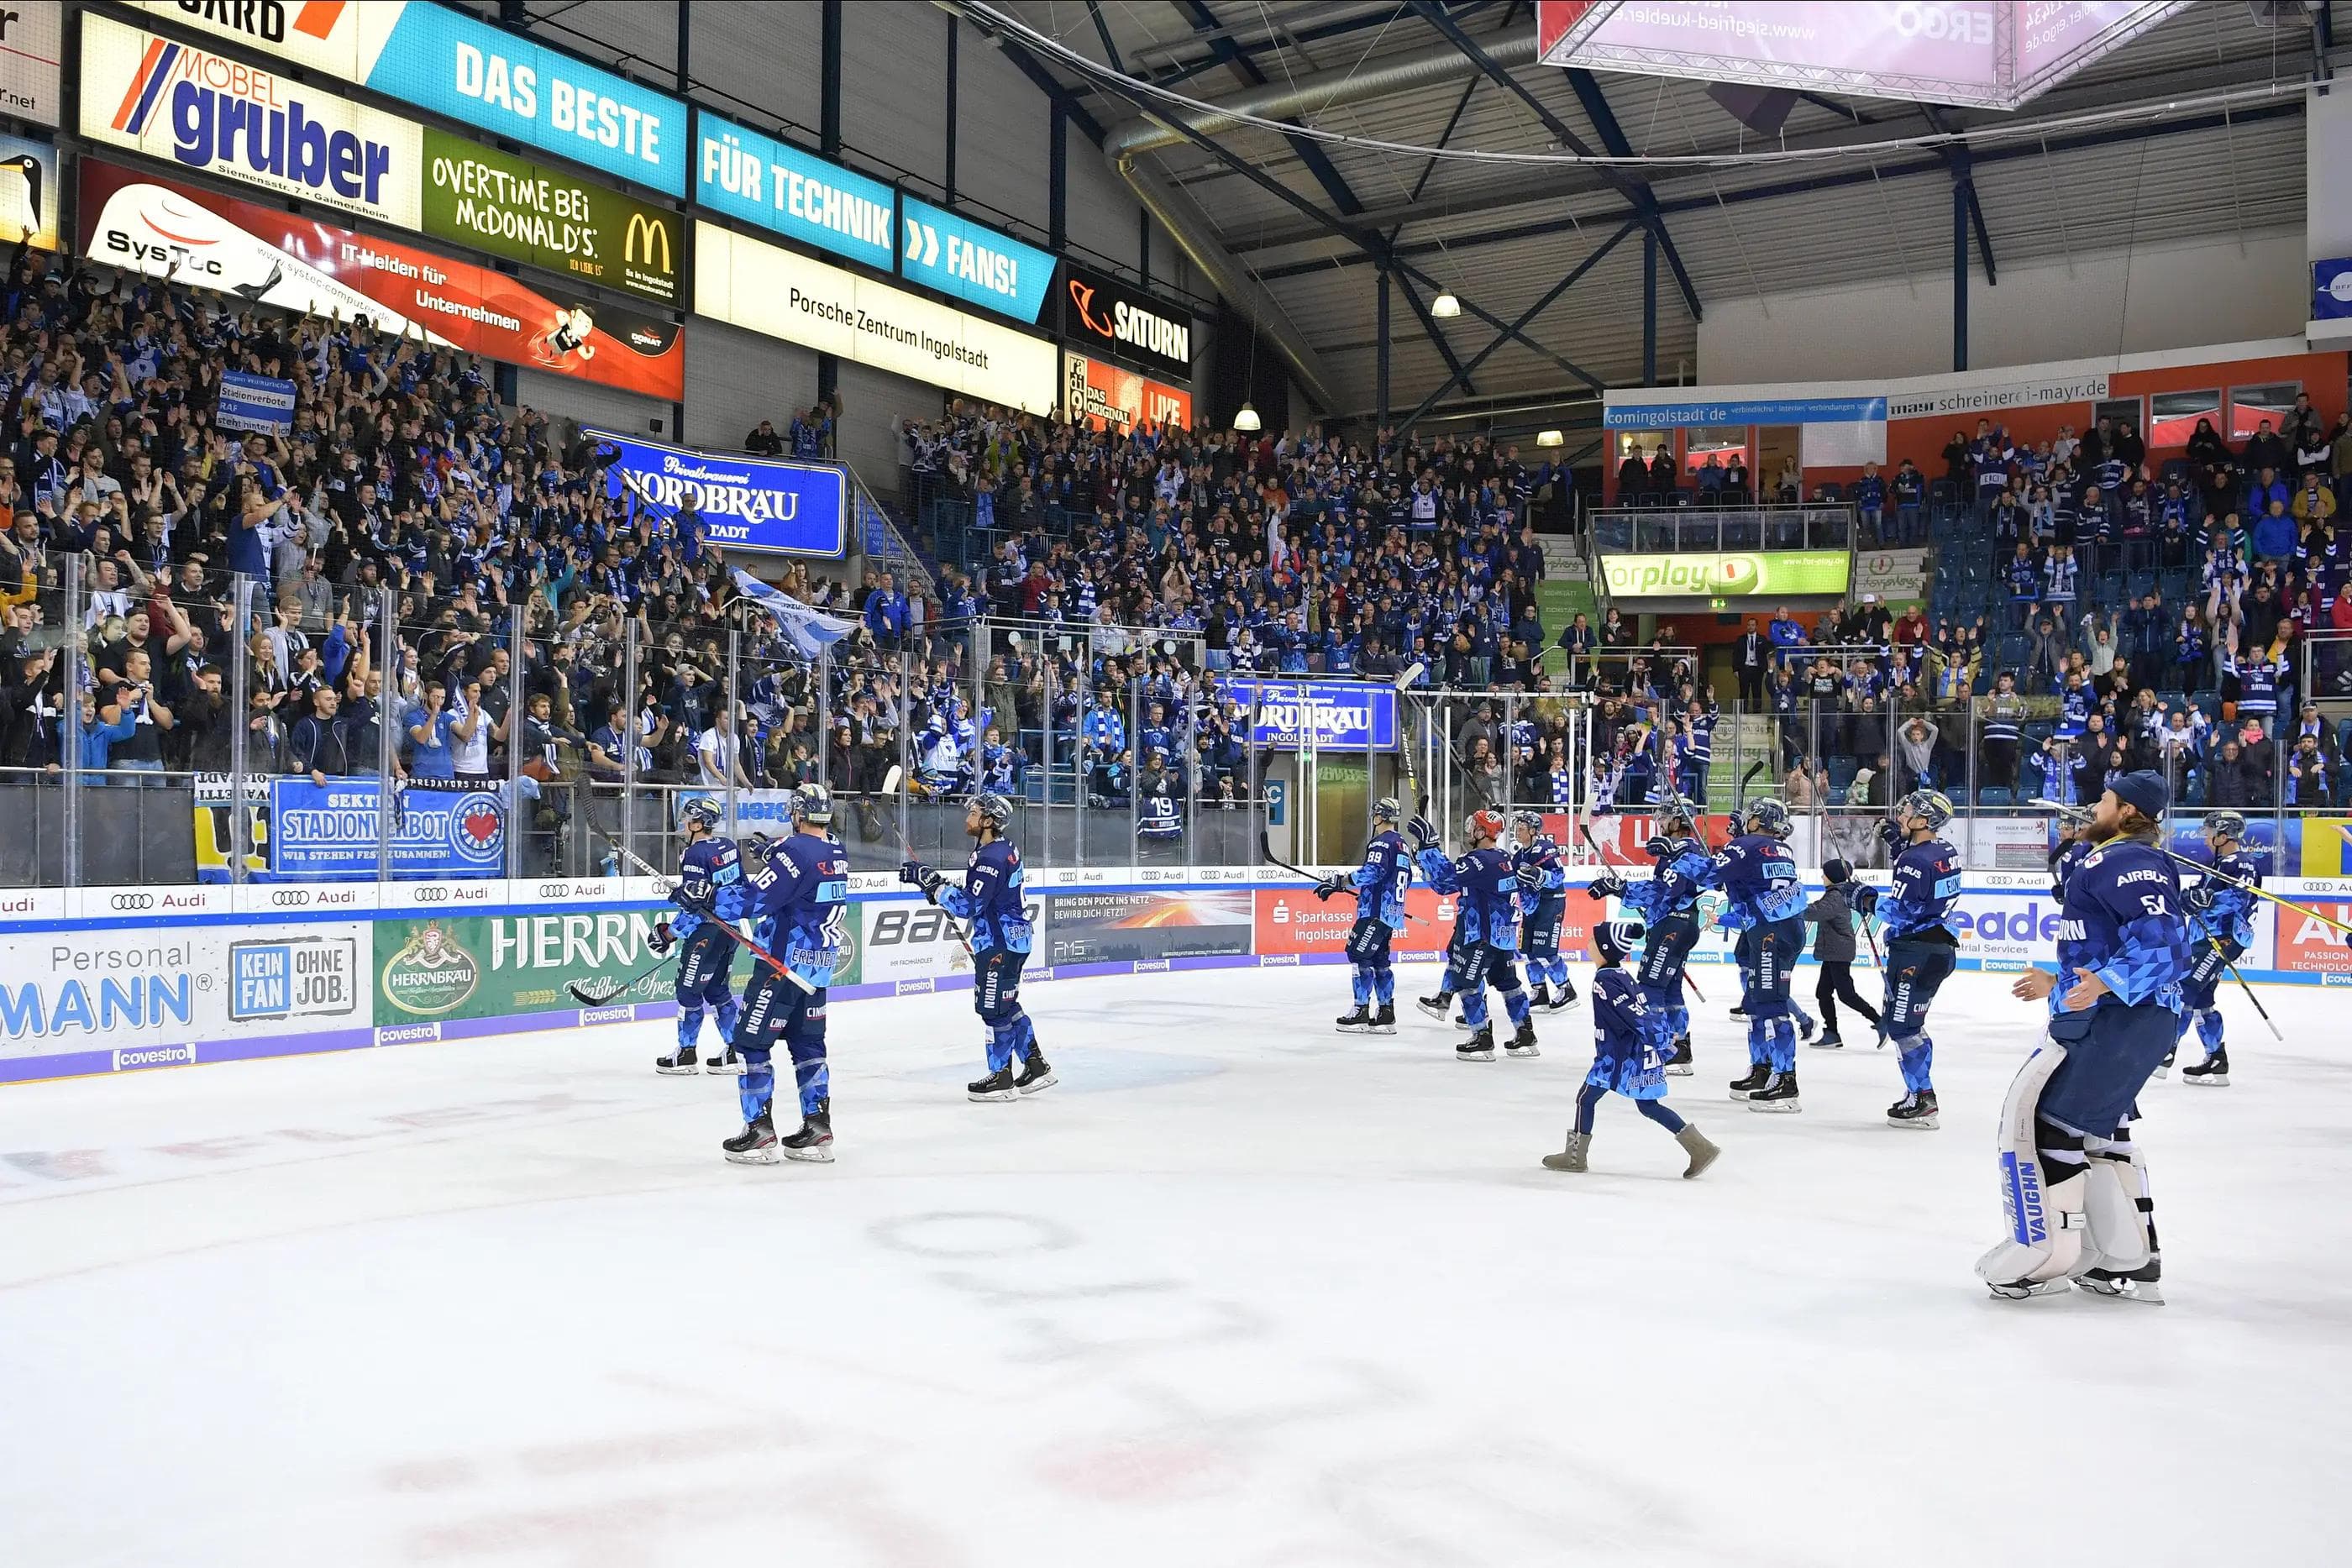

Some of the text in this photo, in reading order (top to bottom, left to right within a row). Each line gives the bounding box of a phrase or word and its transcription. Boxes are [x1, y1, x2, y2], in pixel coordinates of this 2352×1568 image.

[172, 47, 283, 109] MÖBEL
[456, 40, 660, 165] DAS BESTE
[171, 80, 390, 206] gruber
[218, 164, 292, 193] Siemensstr.
[314, 192, 390, 220] Gaimersheim
[703, 134, 892, 250] FÜR TECHNIK
[947, 234, 1017, 297] FANS!
[422, 265, 448, 286] für
[643, 271, 675, 290] Ingolstadt
[416, 289, 520, 332] Unternehmen
[789, 287, 990, 371] Porsche Zentrum Ingolstadt
[1114, 301, 1189, 363] SATURN
[221, 386, 286, 406] Stadionverbote
[1087, 387, 1106, 403] DAS
[1087, 401, 1130, 425] ORIGINAL
[1149, 391, 1180, 426] LIVE
[218, 417, 270, 432] steht hinter
[664, 455, 751, 485] Privatbrauerei
[622, 467, 800, 524] NORDBRÄU
[1150, 796, 1173, 816] 19
[282, 851, 306, 861] WIR
[308, 850, 354, 861] STEHEN
[1367, 851, 1383, 864] 89
[753, 866, 779, 890] 16
[866, 876, 889, 888] Audi
[1083, 871, 1104, 882] Audi
[1163, 870, 1184, 881] Audi
[1223, 869, 1245, 880] Audi
[1624, 870, 1650, 878] Audi
[1852, 873, 1879, 882] Audi
[2017, 876, 2045, 886] Audi
[317, 890, 356, 904] Audi
[454, 887, 488, 899] Audi
[574, 884, 606, 896] Audi
[972, 879, 984, 897] 9
[0, 897, 35, 913] udi
[161, 894, 206, 907] Audi
[1054, 895, 1150, 908] BRING DEN PUCK INS NETZ
[1054, 909, 1082, 920] BEWIRB
[1083, 908, 1101, 918] DICH
[1294, 910, 1353, 926] Sparkasse
[1356, 924, 1377, 954] SATURN
[52, 941, 192, 972] Personal
[791, 947, 814, 966] ERC
[1263, 954, 1297, 964] covestro
[1401, 951, 1436, 961] covestro
[1686, 952, 1720, 962] ovestro
[1984, 944, 2029, 955] Services
[2304, 952, 2349, 960] PASSION
[241, 951, 284, 978] KEIN
[296, 949, 344, 974] OHNE
[683, 953, 701, 988] SATURN
[1136, 959, 1166, 971] covestro
[1465, 948, 1484, 981] SATURN
[1649, 946, 1669, 980] SATURN
[1761, 951, 1773, 989] SATURN
[1986, 960, 2028, 970] covestro
[2292, 961, 2352, 971] TECHNOLO
[392, 968, 471, 987] HERRNBRÄU
[1022, 968, 1051, 981] covestro
[241, 978, 284, 1009] FAN
[297, 975, 347, 1005] JOB.
[899, 980, 932, 993] covestro
[984, 971, 999, 1009] SATURN
[1893, 981, 1911, 1023] SATURN
[583, 1007, 630, 1023] covestro
[745, 989, 774, 1035] SATURN
[379, 1025, 434, 1043] covestro
[118, 1047, 189, 1067] covestro
[2019, 1162, 2047, 1244] VAUGHN
